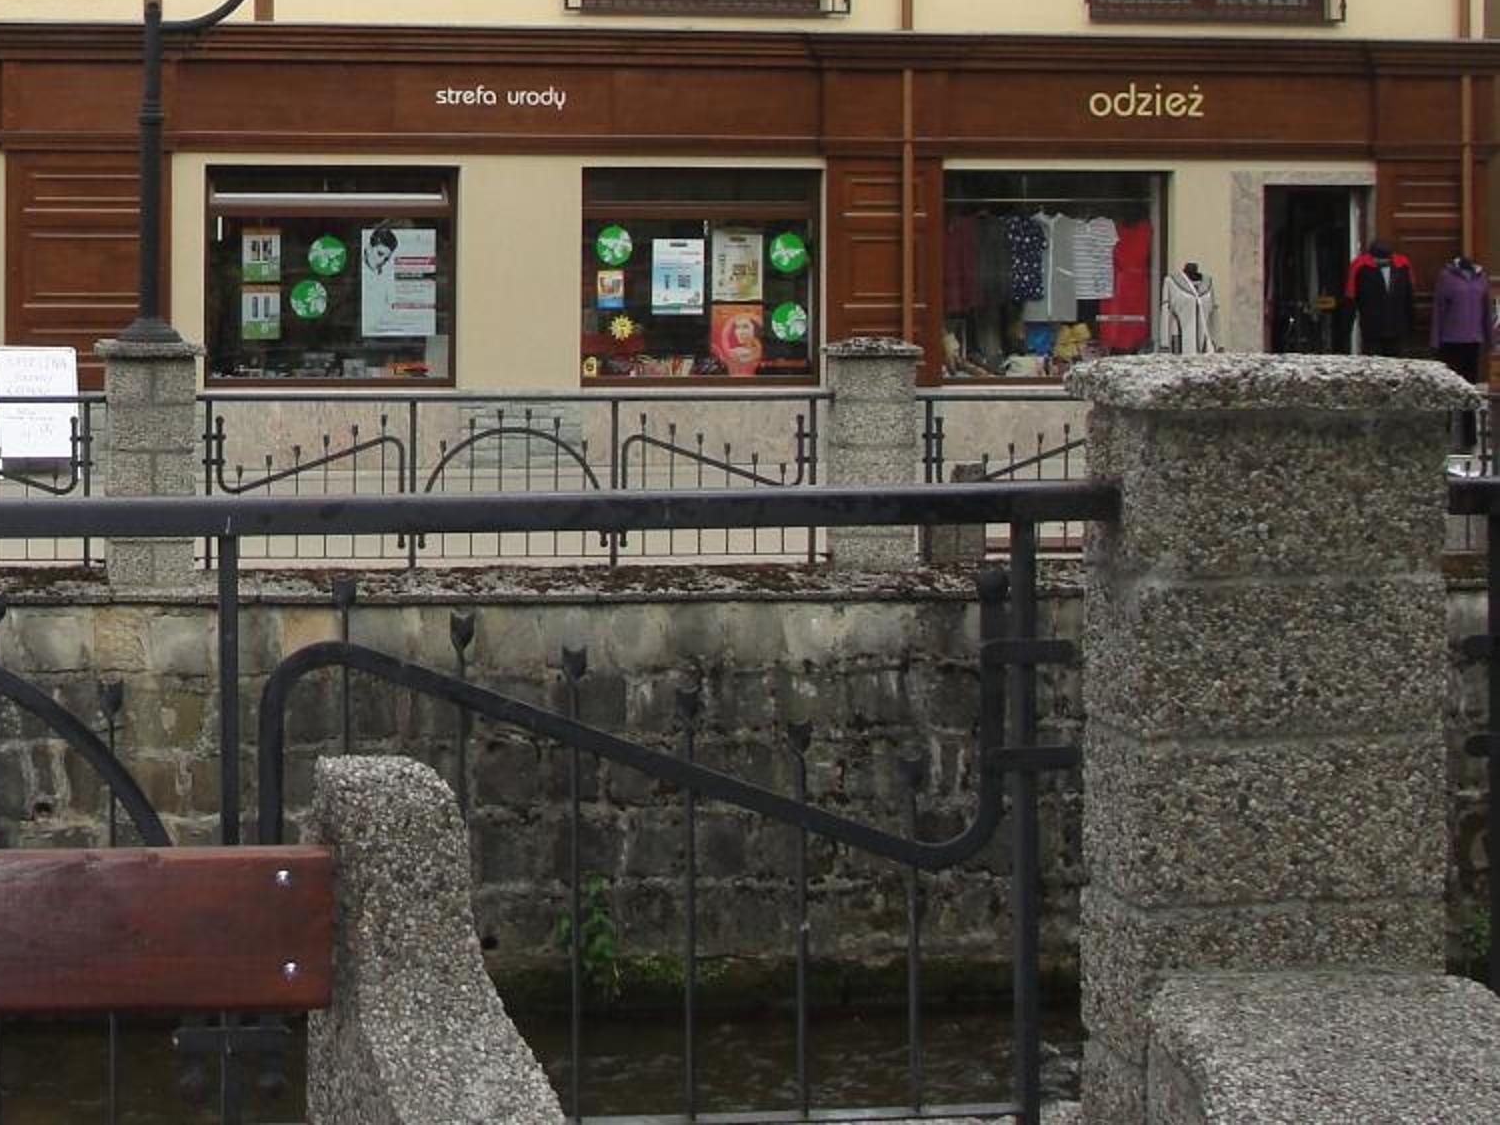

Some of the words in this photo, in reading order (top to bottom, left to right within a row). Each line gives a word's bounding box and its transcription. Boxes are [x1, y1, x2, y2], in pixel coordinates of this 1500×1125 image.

[434, 84, 497, 106] strefa
[507, 85, 567, 111] urody
[1089, 82, 1205, 117] odzież
